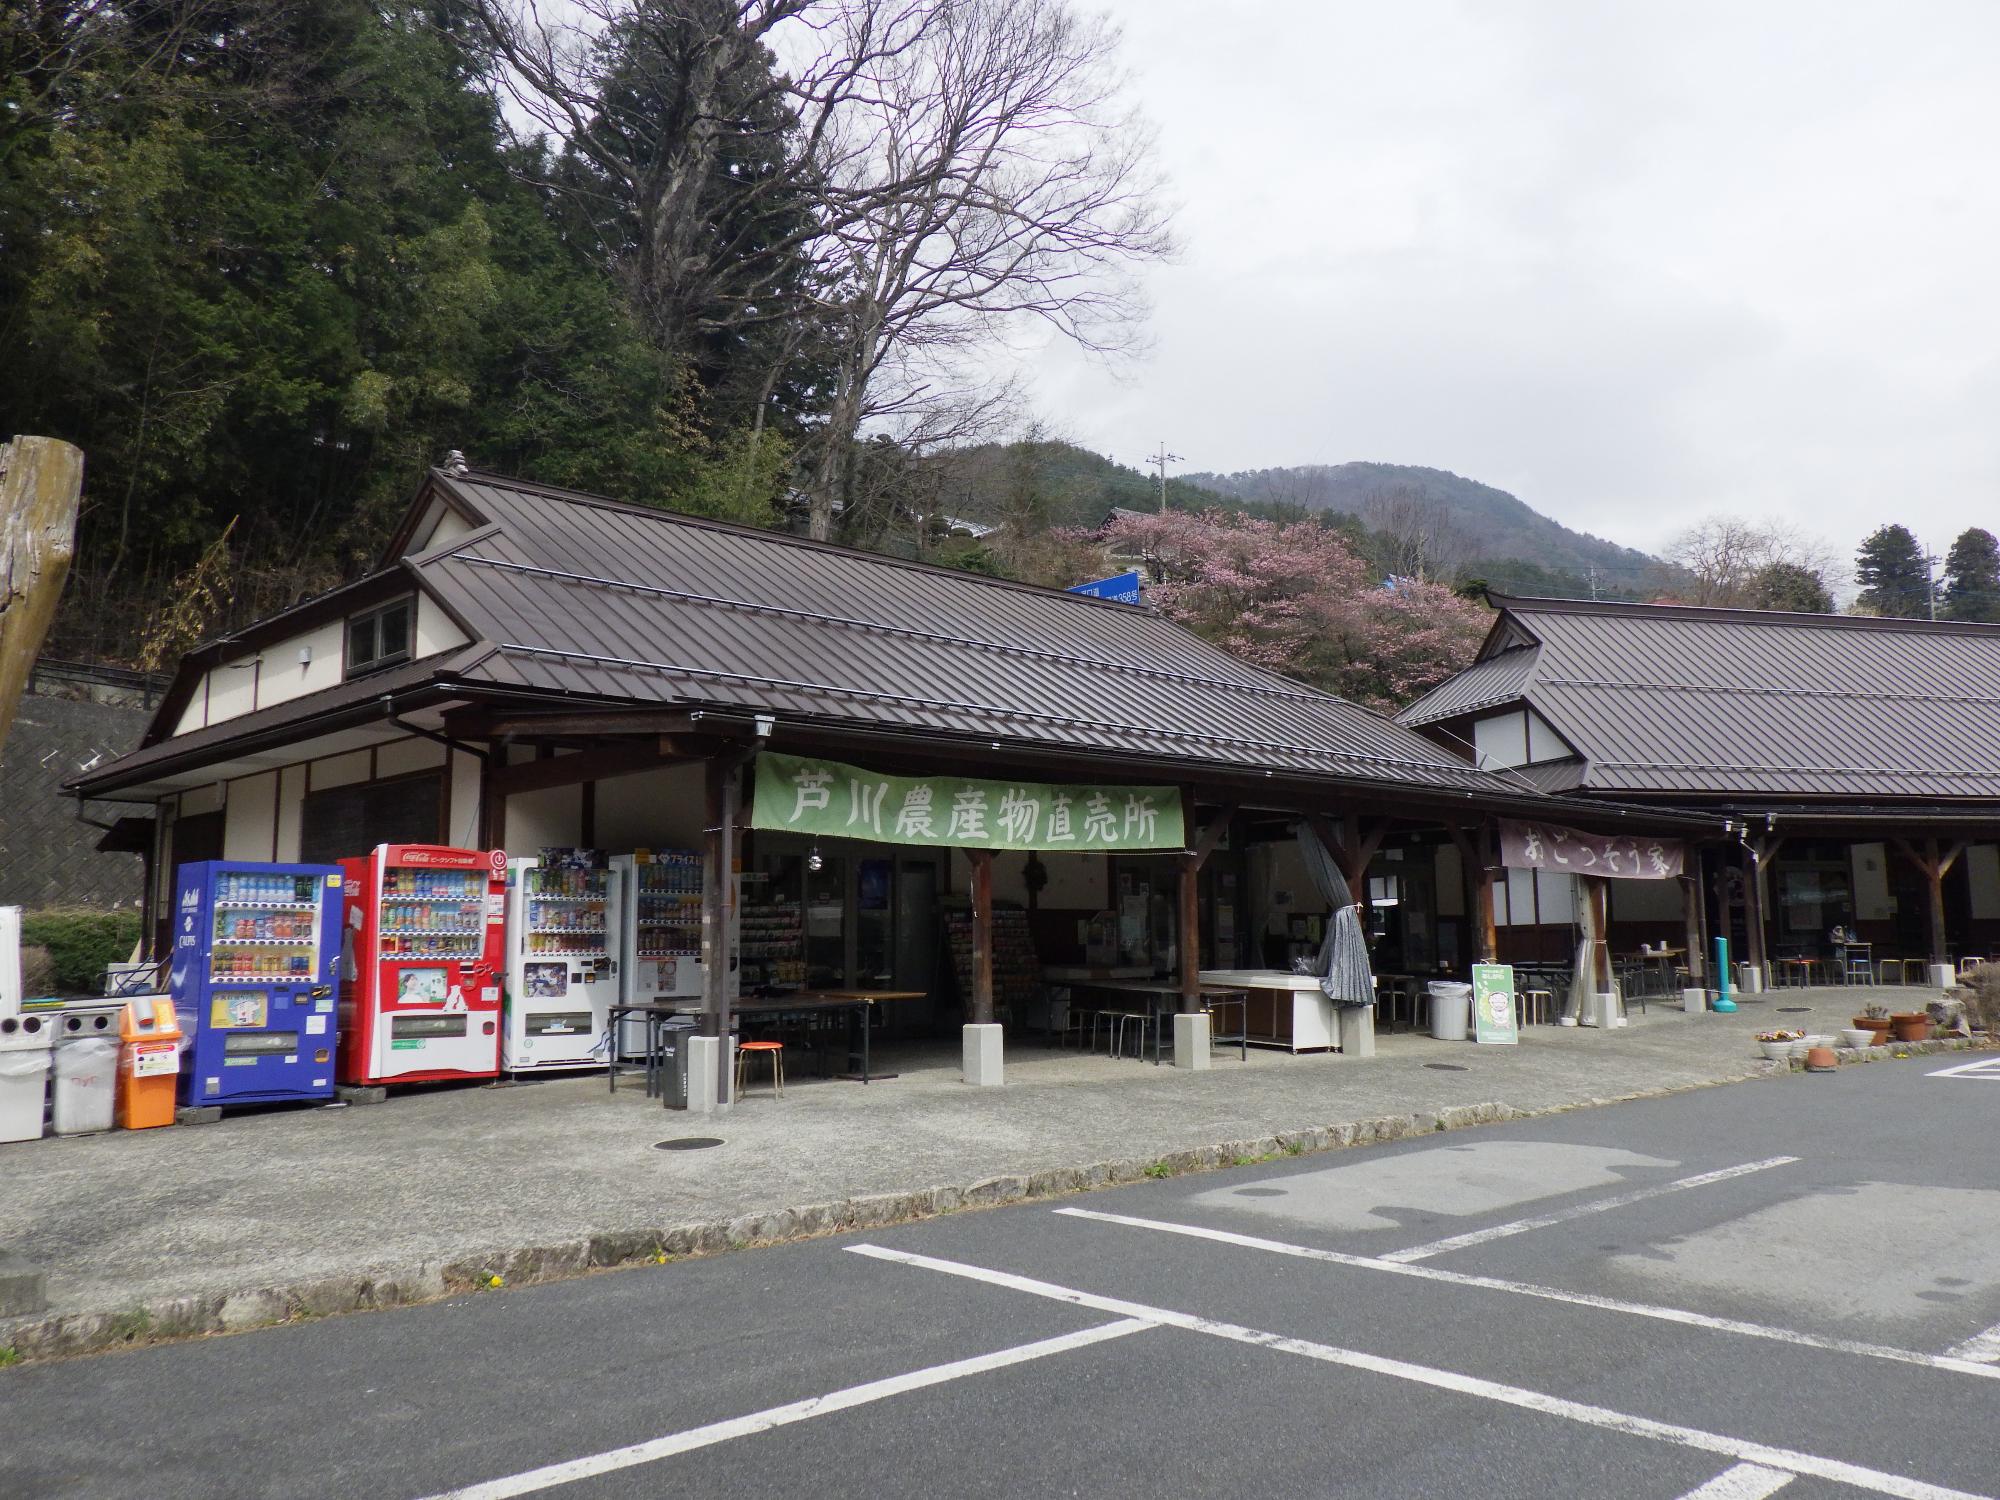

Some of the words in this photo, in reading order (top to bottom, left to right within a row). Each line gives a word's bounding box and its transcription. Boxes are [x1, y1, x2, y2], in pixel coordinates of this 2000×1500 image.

[788, 769, 1160, 843] 芦川農産物直売所
